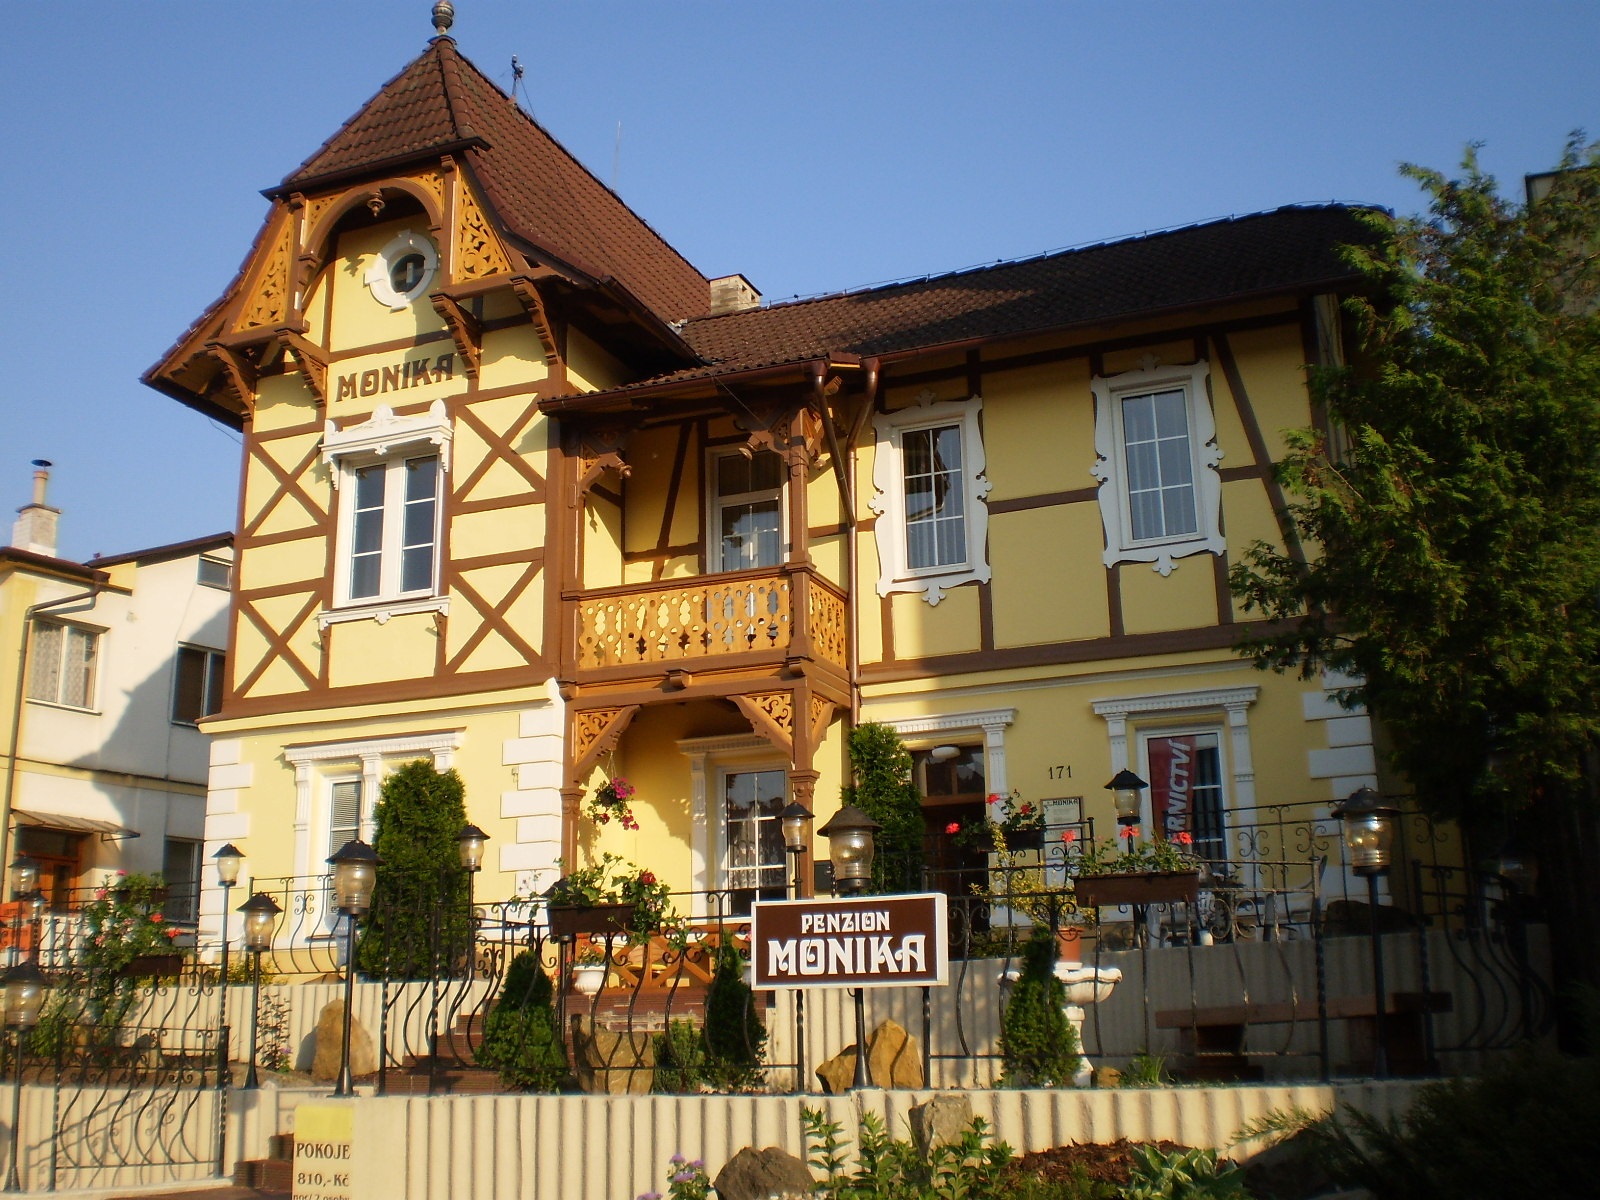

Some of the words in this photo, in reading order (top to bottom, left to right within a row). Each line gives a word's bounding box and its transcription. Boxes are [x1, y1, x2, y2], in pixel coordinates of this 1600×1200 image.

[335, 352, 454, 402] MONIKA
[1048, 765, 1072, 780] 171
[801, 911, 890, 934] PENZION
[767, 935, 927, 977] MONIKA
[296, 1143, 351, 1160] POKOJE
